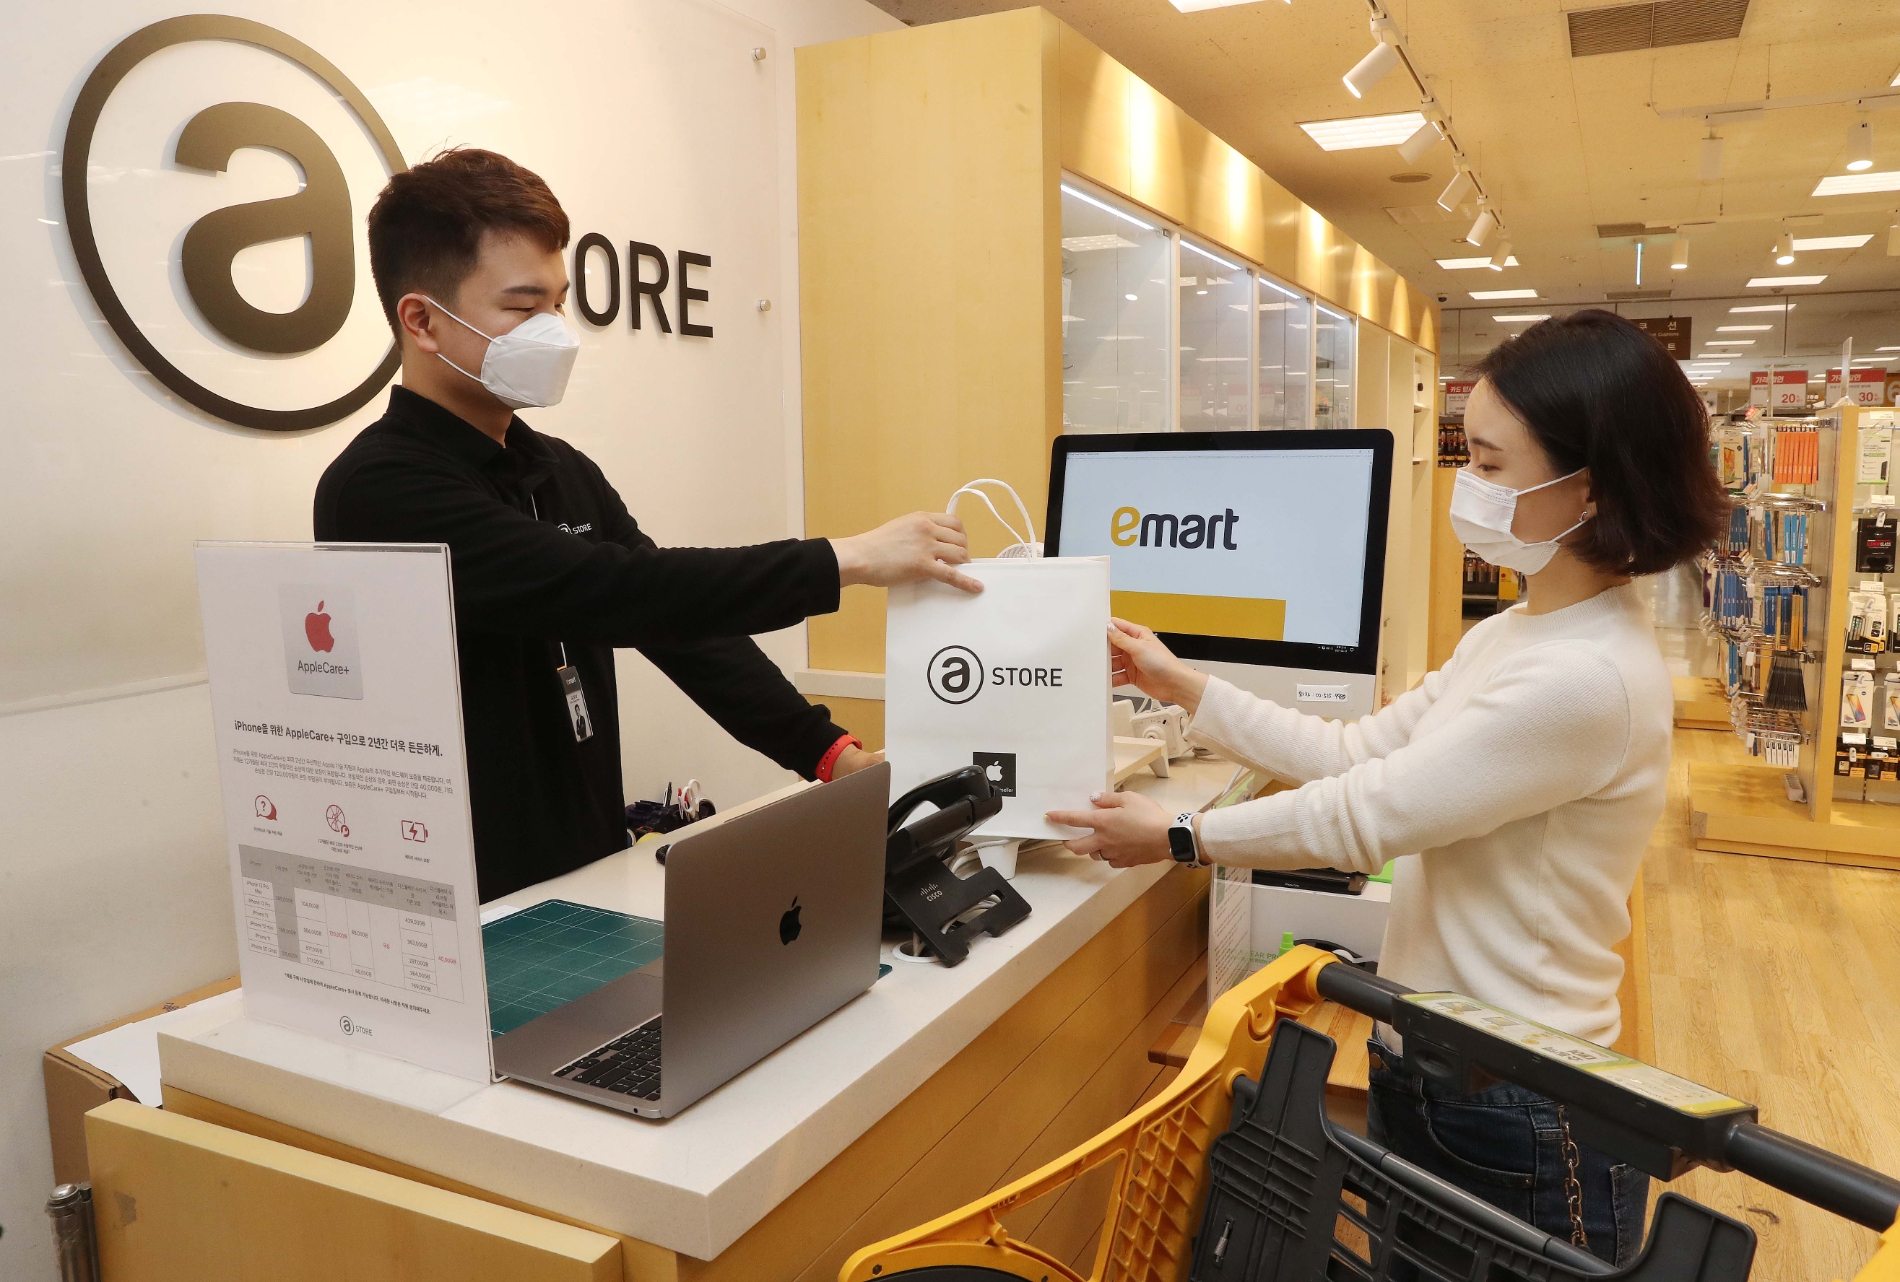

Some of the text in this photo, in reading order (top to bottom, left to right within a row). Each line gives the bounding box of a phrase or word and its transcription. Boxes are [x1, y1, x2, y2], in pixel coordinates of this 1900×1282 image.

[574, 232, 714, 339] ORE
[1782, 394, 1796, 404] 20
[1858, 392, 1873, 402] 30
[572, 522, 592, 534] STORE
[1110, 506, 1240, 550] emart
[297, 660, 350, 676] AppleCare+
[991, 666, 1063, 688] STORE
[234, 720, 443, 756] iPhone을 위한 AppleCare+ 구입으로 2년간 더욱 든든하게.
[322, 760, 334, 768] Apple
[356, 1026, 373, 1036] STORE
